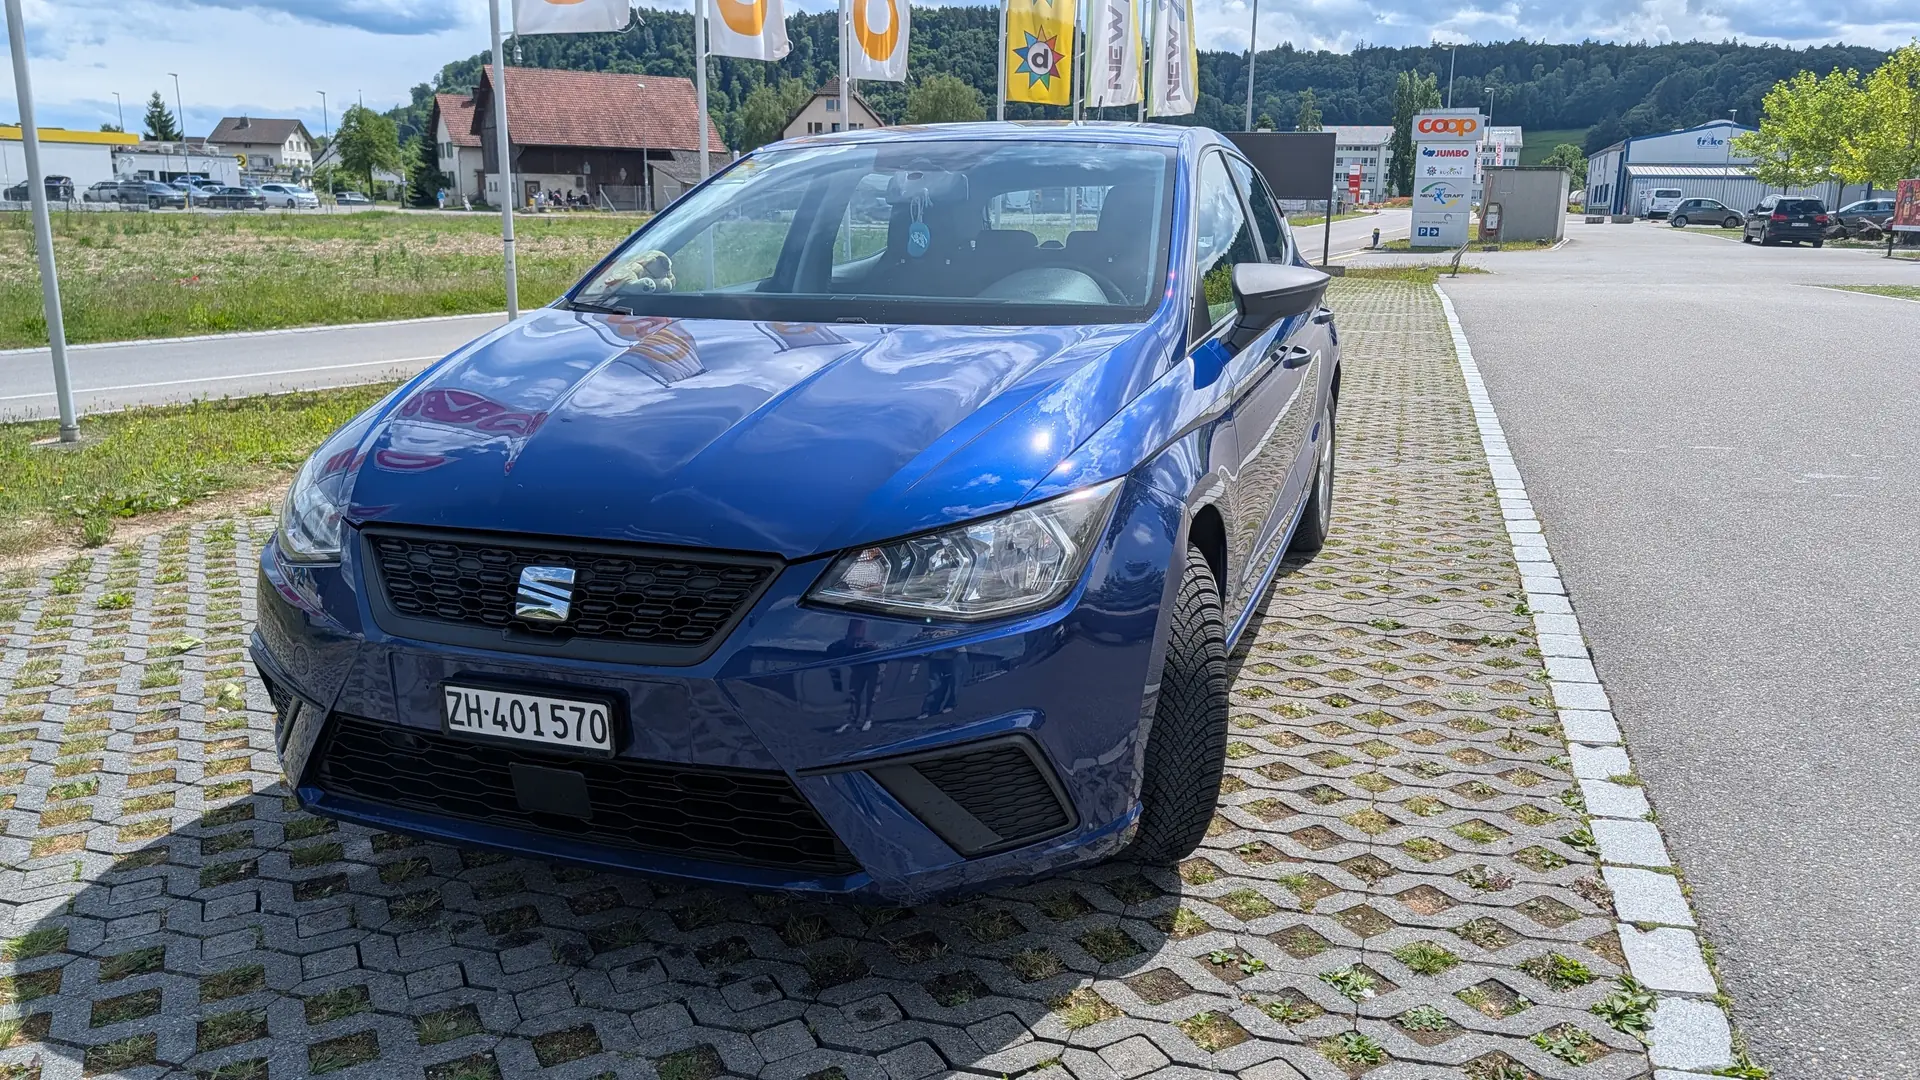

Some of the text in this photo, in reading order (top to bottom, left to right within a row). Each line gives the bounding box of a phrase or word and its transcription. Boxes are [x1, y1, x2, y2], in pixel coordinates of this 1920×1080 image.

[1108, 5, 1122, 89] NEW
[1031, 49, 1048, 68] d
[1166, 25, 1180, 101] NEW
[1418, 119, 1476, 136] coop
[1435, 149, 1469, 157] JUMBO
